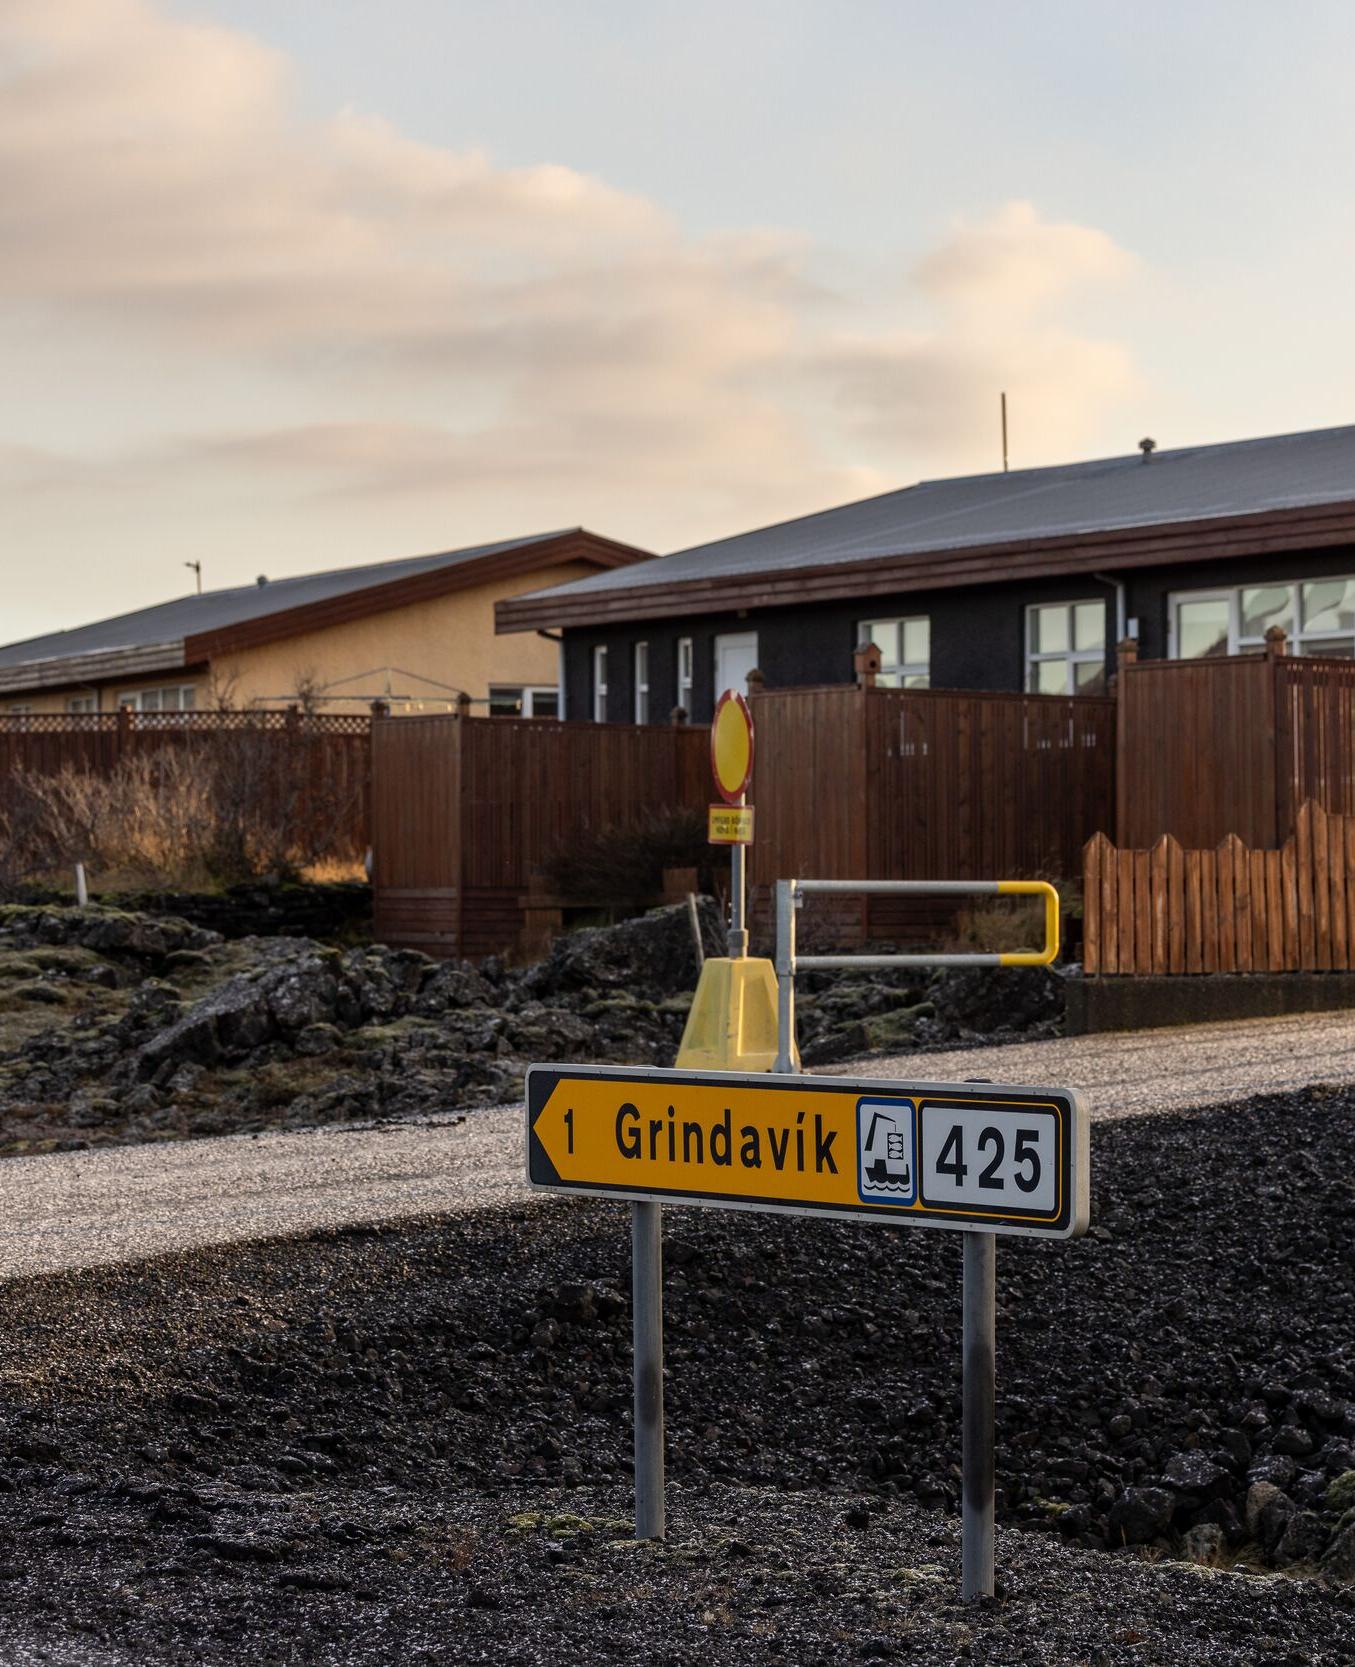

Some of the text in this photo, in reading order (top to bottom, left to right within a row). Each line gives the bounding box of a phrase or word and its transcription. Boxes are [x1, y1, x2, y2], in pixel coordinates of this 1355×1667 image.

[563, 1102, 1041, 1193] 1 Grindavík 425
